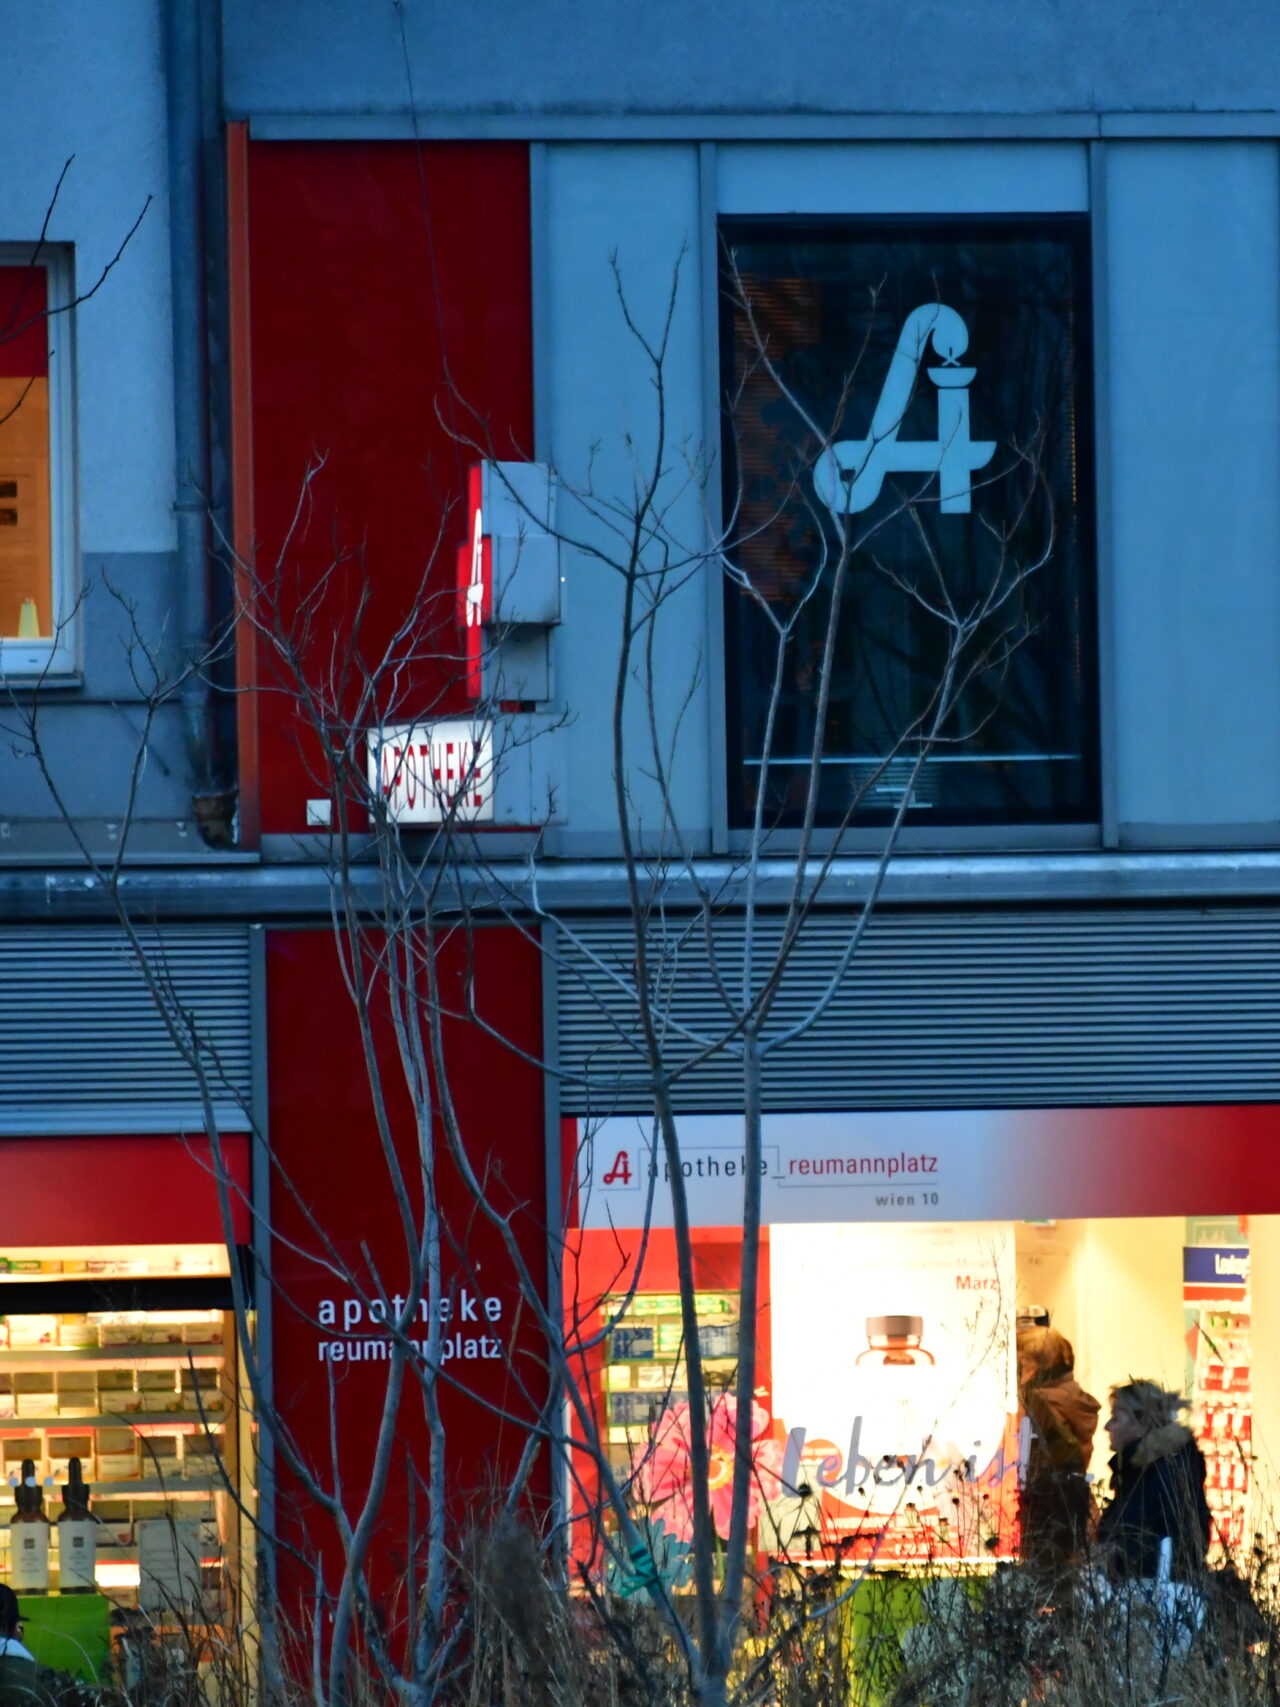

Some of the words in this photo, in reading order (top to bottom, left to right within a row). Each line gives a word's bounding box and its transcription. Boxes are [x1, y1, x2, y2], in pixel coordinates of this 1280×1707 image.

[382, 742, 482, 810] APOTHEKE
[875, 1193, 915, 1206] wien
[923, 1192, 938, 1206] 10
[318, 1332, 502, 1365] reumplatz
